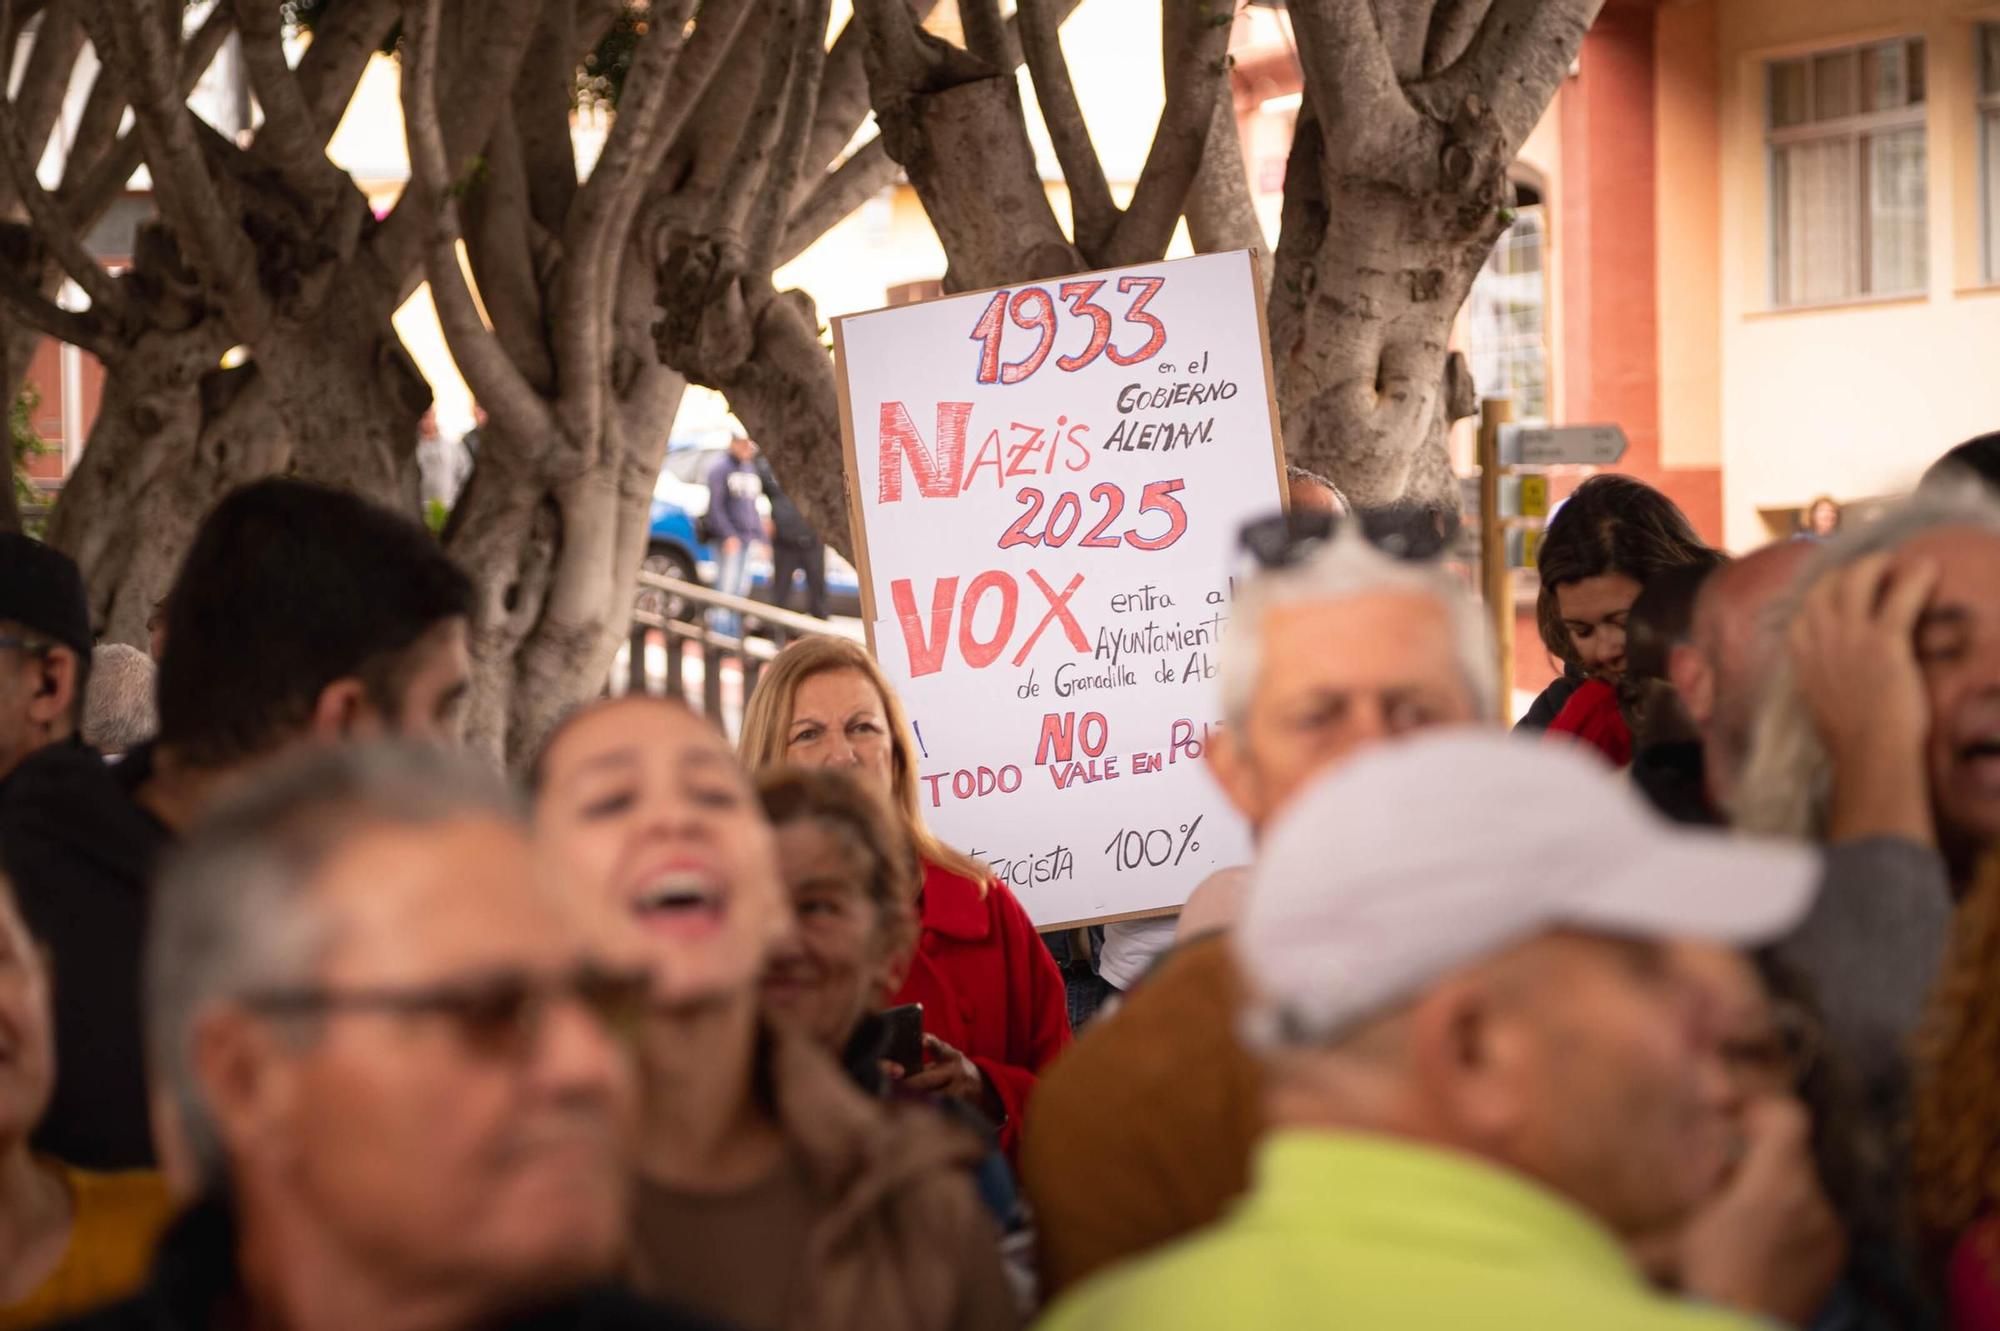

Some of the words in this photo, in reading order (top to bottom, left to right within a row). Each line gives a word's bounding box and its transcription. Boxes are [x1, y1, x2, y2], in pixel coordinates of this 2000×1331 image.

[969, 276, 1167, 385] 1933
[1158, 362, 1176, 374] en
[1188, 351, 1208, 374] el
[1102, 418, 1214, 452] ALEMAN.
[998, 478, 1188, 551] 2025
[891, 568, 1093, 678] VOX
[1111, 585, 1176, 613] entra
[1016, 668, 1040, 699] de
[1054, 663, 1137, 697] Granadilla
[1155, 659, 1176, 684] de
[1034, 711, 1108, 765] NO
[920, 764, 1022, 807] TODO
[1049, 756, 1120, 790] VALE
[1132, 752, 1162, 775] EN
